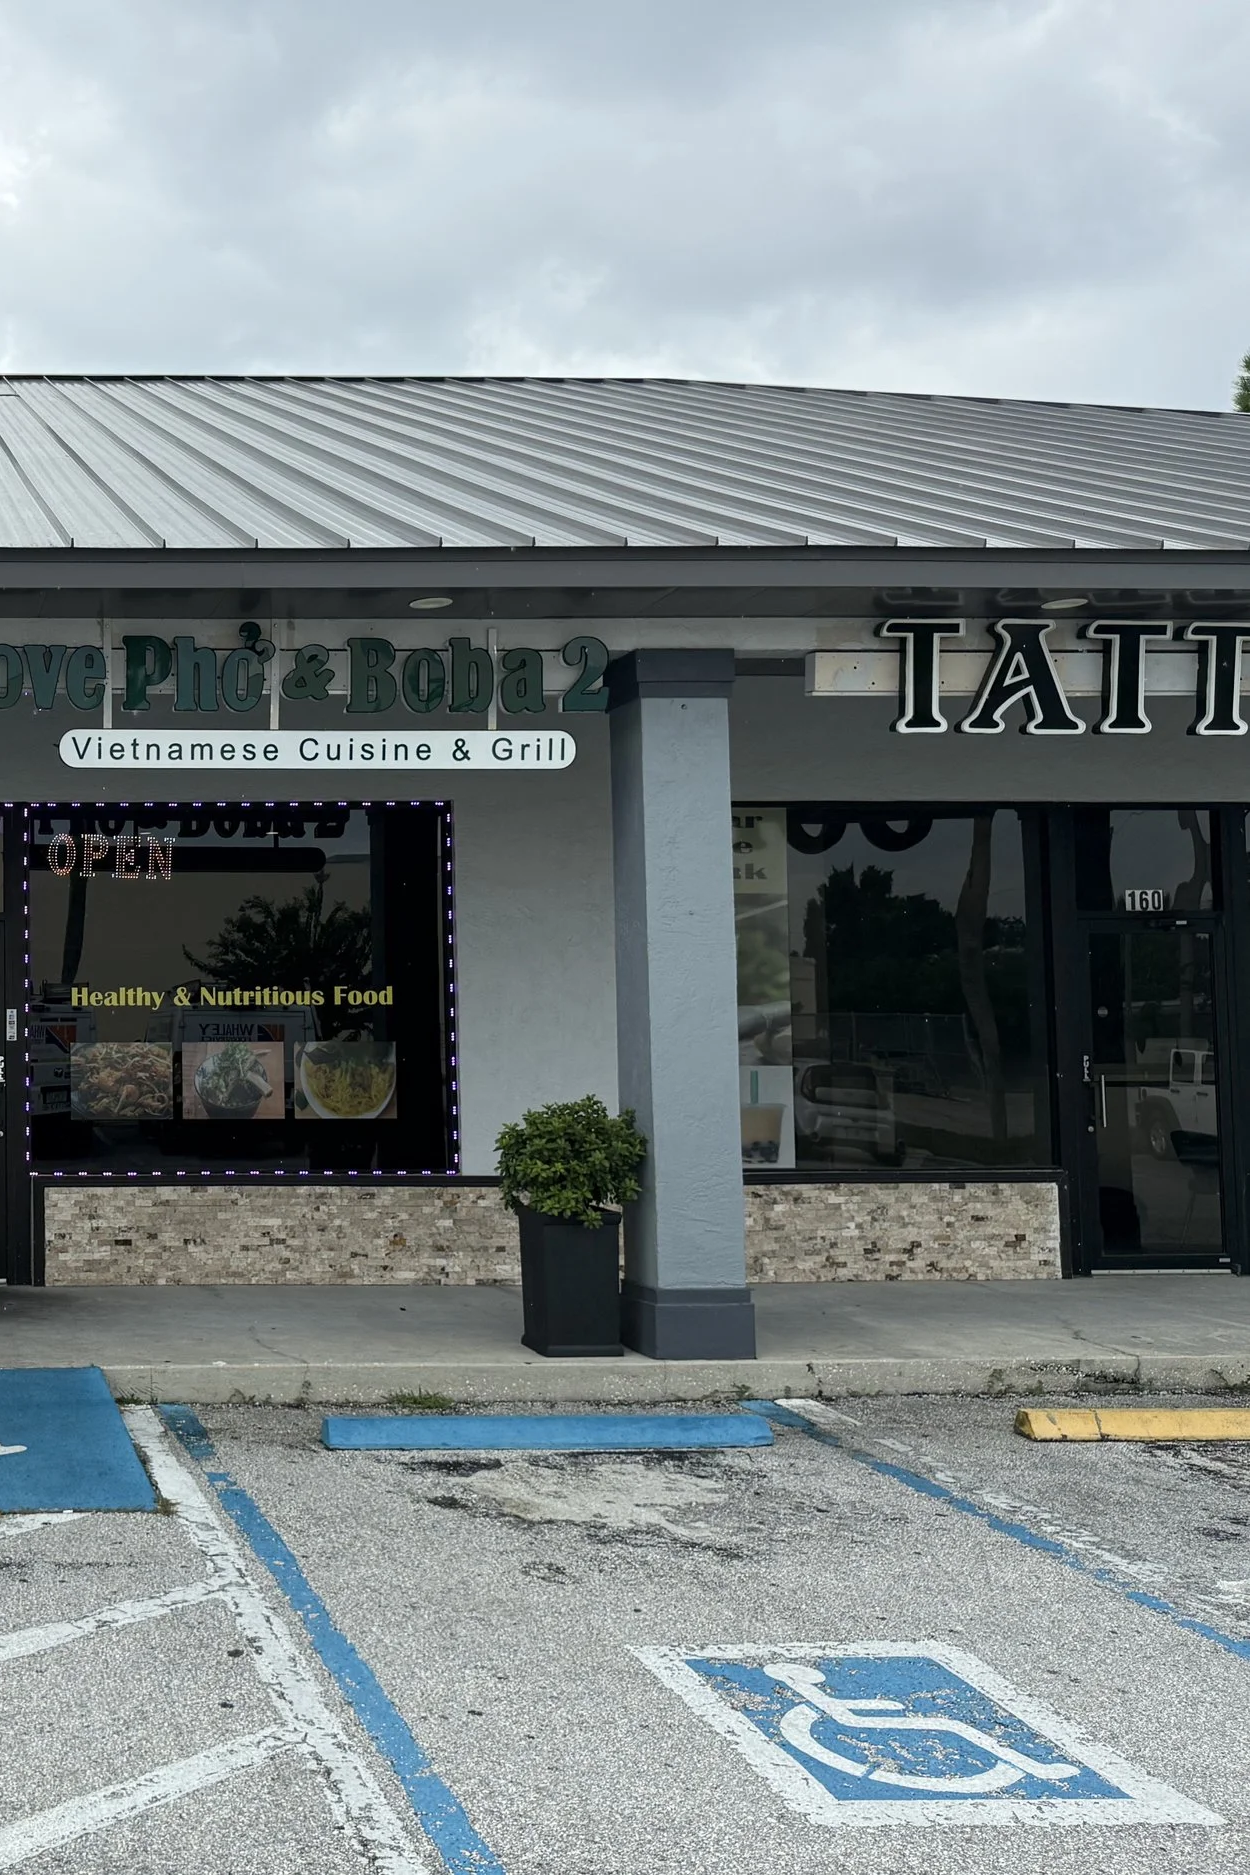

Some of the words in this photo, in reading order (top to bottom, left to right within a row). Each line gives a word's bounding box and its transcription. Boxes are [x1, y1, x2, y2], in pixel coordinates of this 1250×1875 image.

[282, 643, 335, 700] &
[346, 637, 545, 714] Boba
[559, 636, 609, 712] 2
[72, 736, 279, 762] Vietnamese
[299, 736, 432, 762] Cuisine
[453, 737, 471, 761] &
[492, 736, 567, 762] Grill
[48, 832, 175, 880] OPEN
[1126, 890, 1163, 911] 160
[71, 987, 165, 1010] Healthy
[173, 987, 191, 1006] &
[200, 986, 325, 1006] Nutritious
[333, 985, 394, 1005] Food
